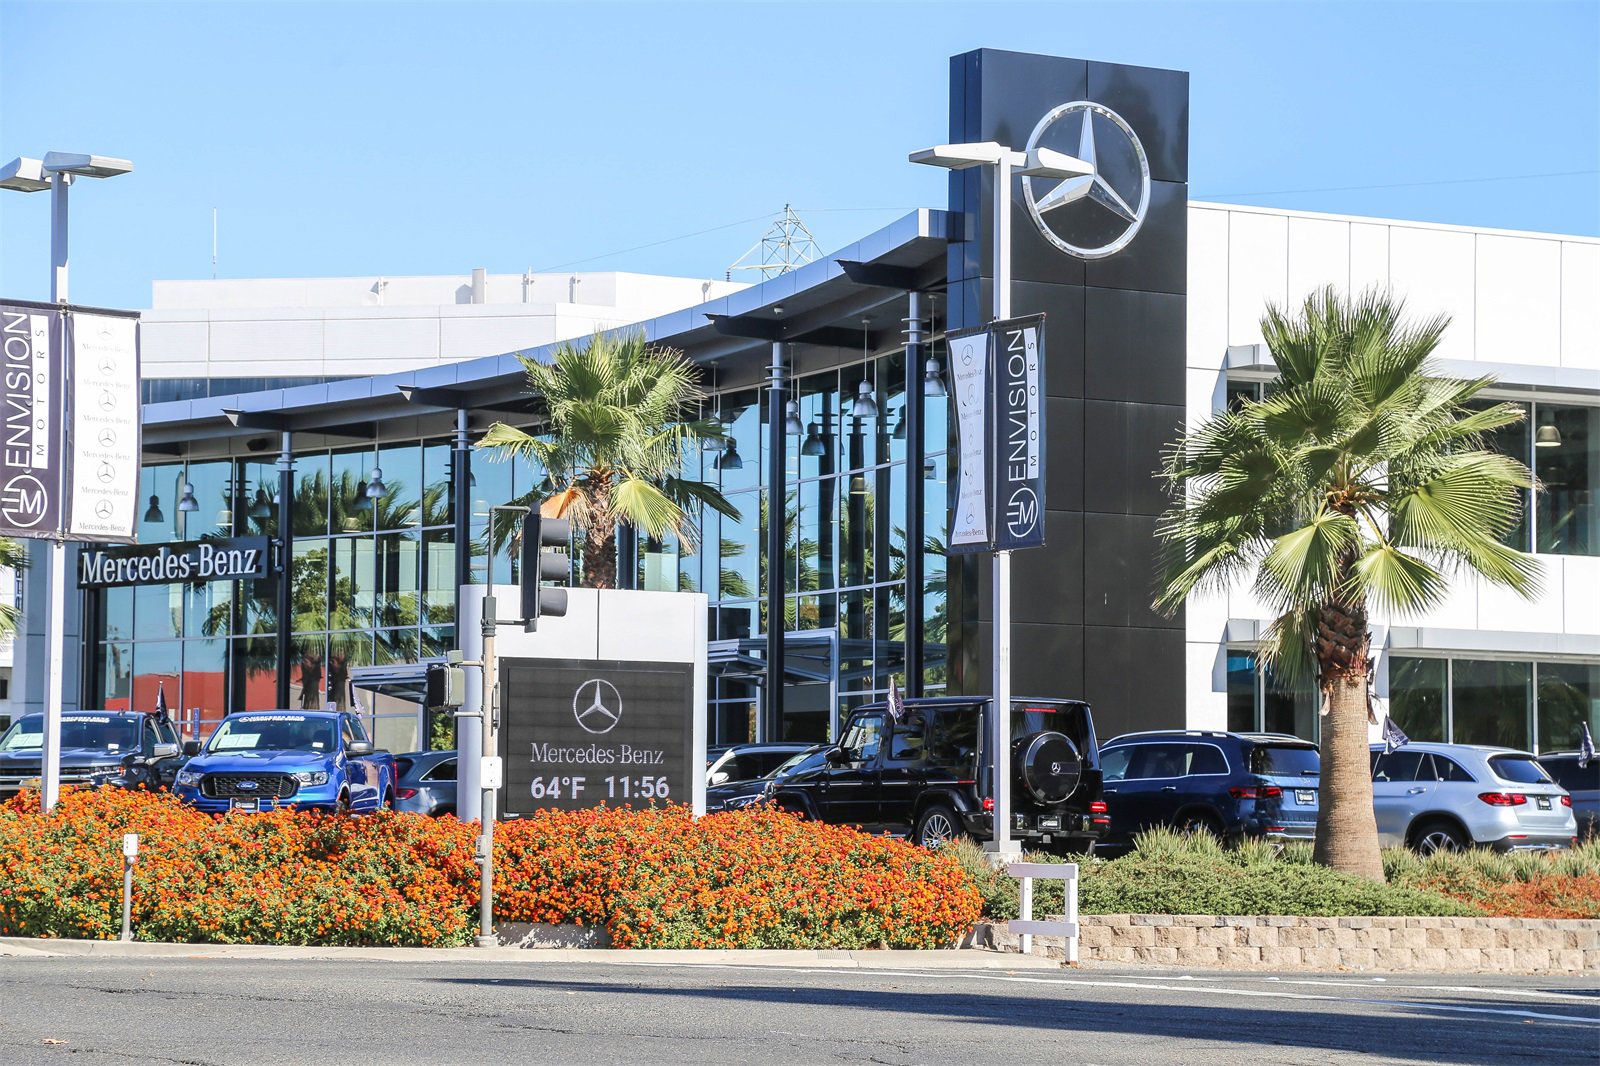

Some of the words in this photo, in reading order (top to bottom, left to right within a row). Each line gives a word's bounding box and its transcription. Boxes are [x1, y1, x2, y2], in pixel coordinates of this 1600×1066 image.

[2, 311, 32, 469] ENVISION
[35, 328, 46, 456] MOTORS
[1006, 329, 1027, 482] ENVISION
[1027, 342, 1037, 467] MOTORS
[79, 522, 127, 532] Mercedes-Benz
[80, 543, 257, 585] Mercedes-Benz
[530, 742, 664, 765] Mercedes-Benz
[530, 776, 586, 799] 64°F
[604, 775, 670, 799] 11:56
